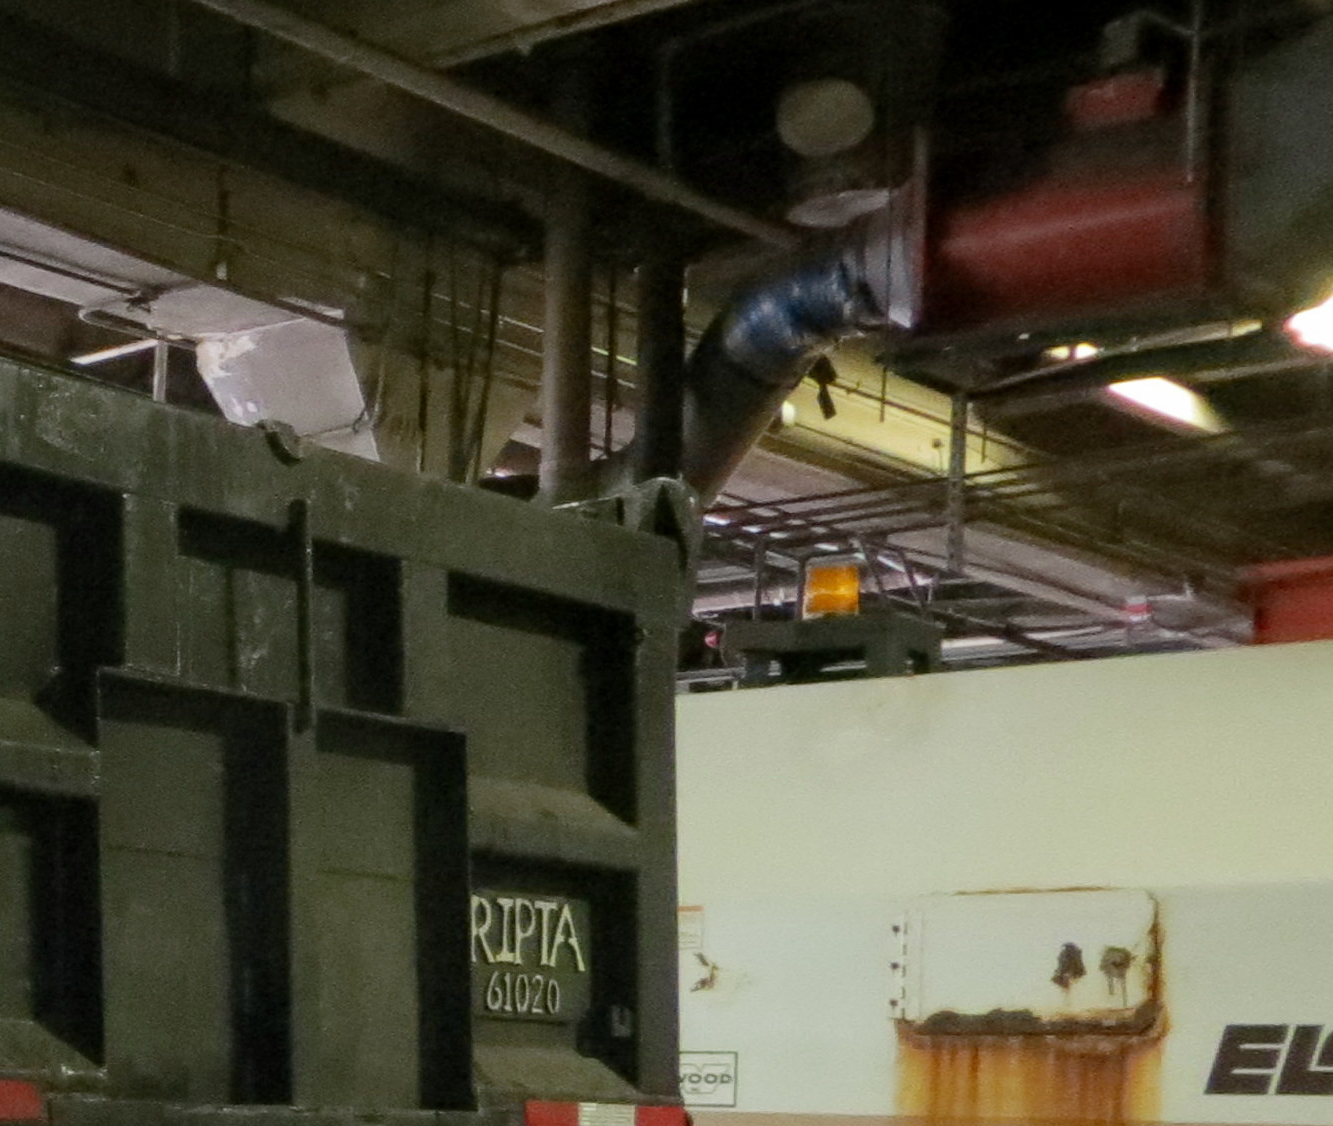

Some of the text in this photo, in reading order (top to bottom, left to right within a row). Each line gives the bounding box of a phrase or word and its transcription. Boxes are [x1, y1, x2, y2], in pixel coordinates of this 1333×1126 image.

[471, 894, 585, 972] RIPTA
[487, 971, 560, 1014] 61020
[1203, 1023, 1333, 1095] EL
